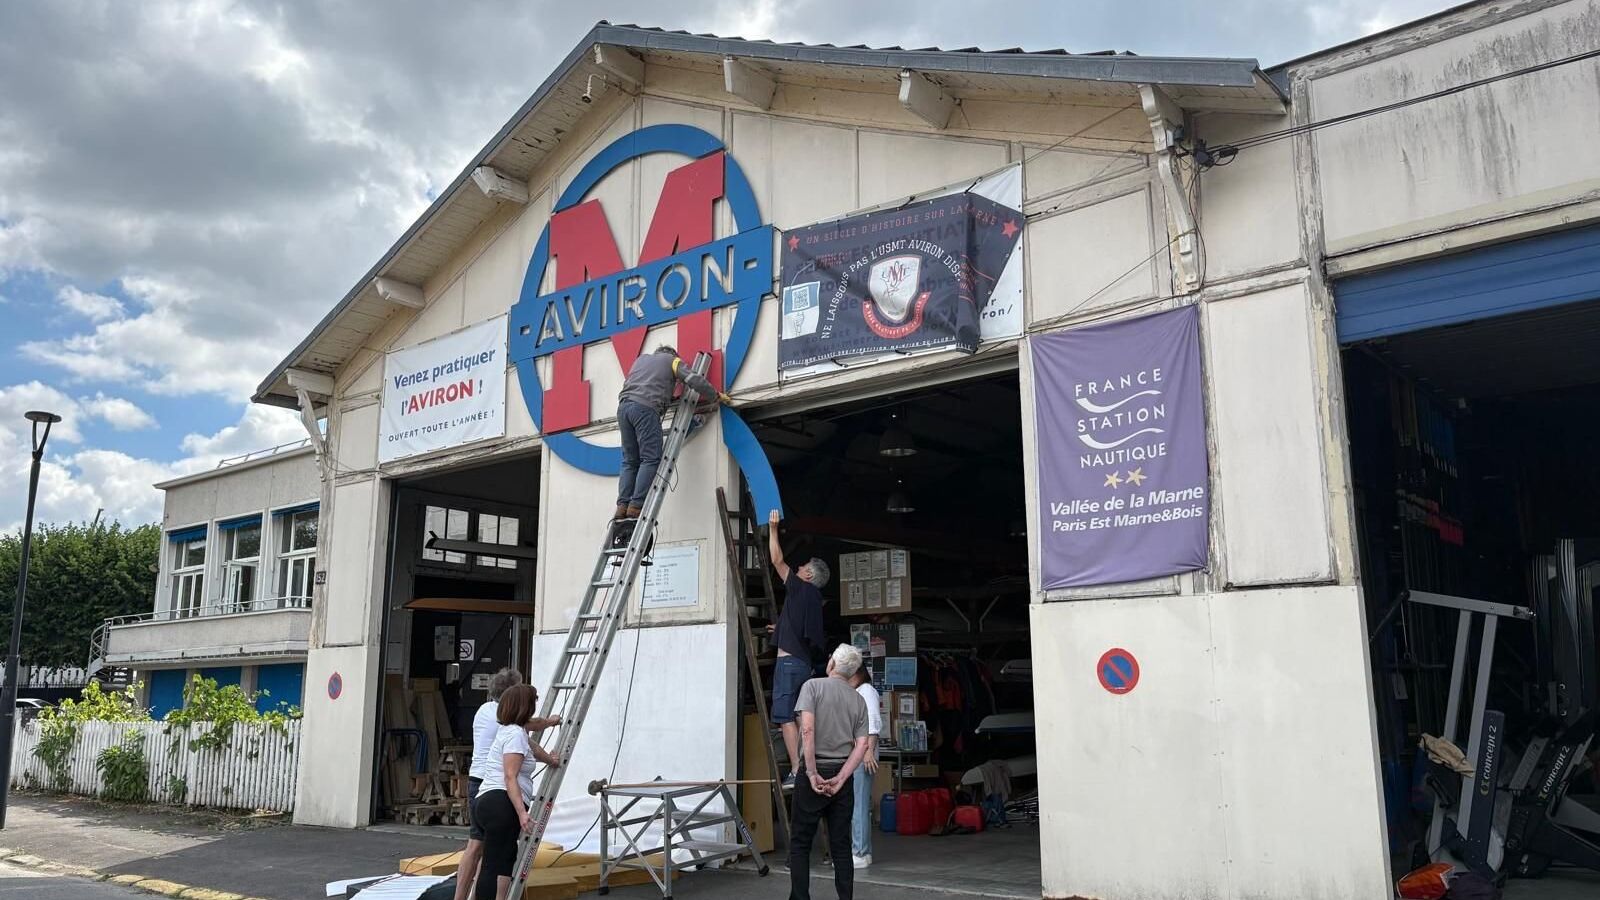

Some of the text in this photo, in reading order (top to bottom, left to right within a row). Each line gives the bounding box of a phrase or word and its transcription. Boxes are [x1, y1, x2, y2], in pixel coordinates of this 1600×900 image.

[806, 235, 820, 245] UN
[861, 214, 920, 234] D'HISTOIRE
[925, 209, 945, 219] SUR
[951, 205, 963, 215] LA
[871, 239, 906, 260] L'USMT
[908, 239, 945, 260] AVIRON
[849, 256, 869, 273] PAS
[826, 272, 849, 321] LAISSONS
[820, 325, 833, 339] NE
[394, 349, 496, 390] Venez pratiquer
[1075, 368, 1162, 397] FRANCE
[401, 379, 474, 416] l'AVIRON
[388, 428, 419, 442] OUVERT
[421, 421, 448, 434] TOUTE
[452, 411, 488, 427] L'ANNÉE
[1077, 404, 1165, 433] STATION
[1080, 442, 1167, 468] NAUTIQUE
[1050, 486, 1204, 516] Vallée de la Marne
[1052, 504, 1203, 532] Paris Est Marne&Bois
